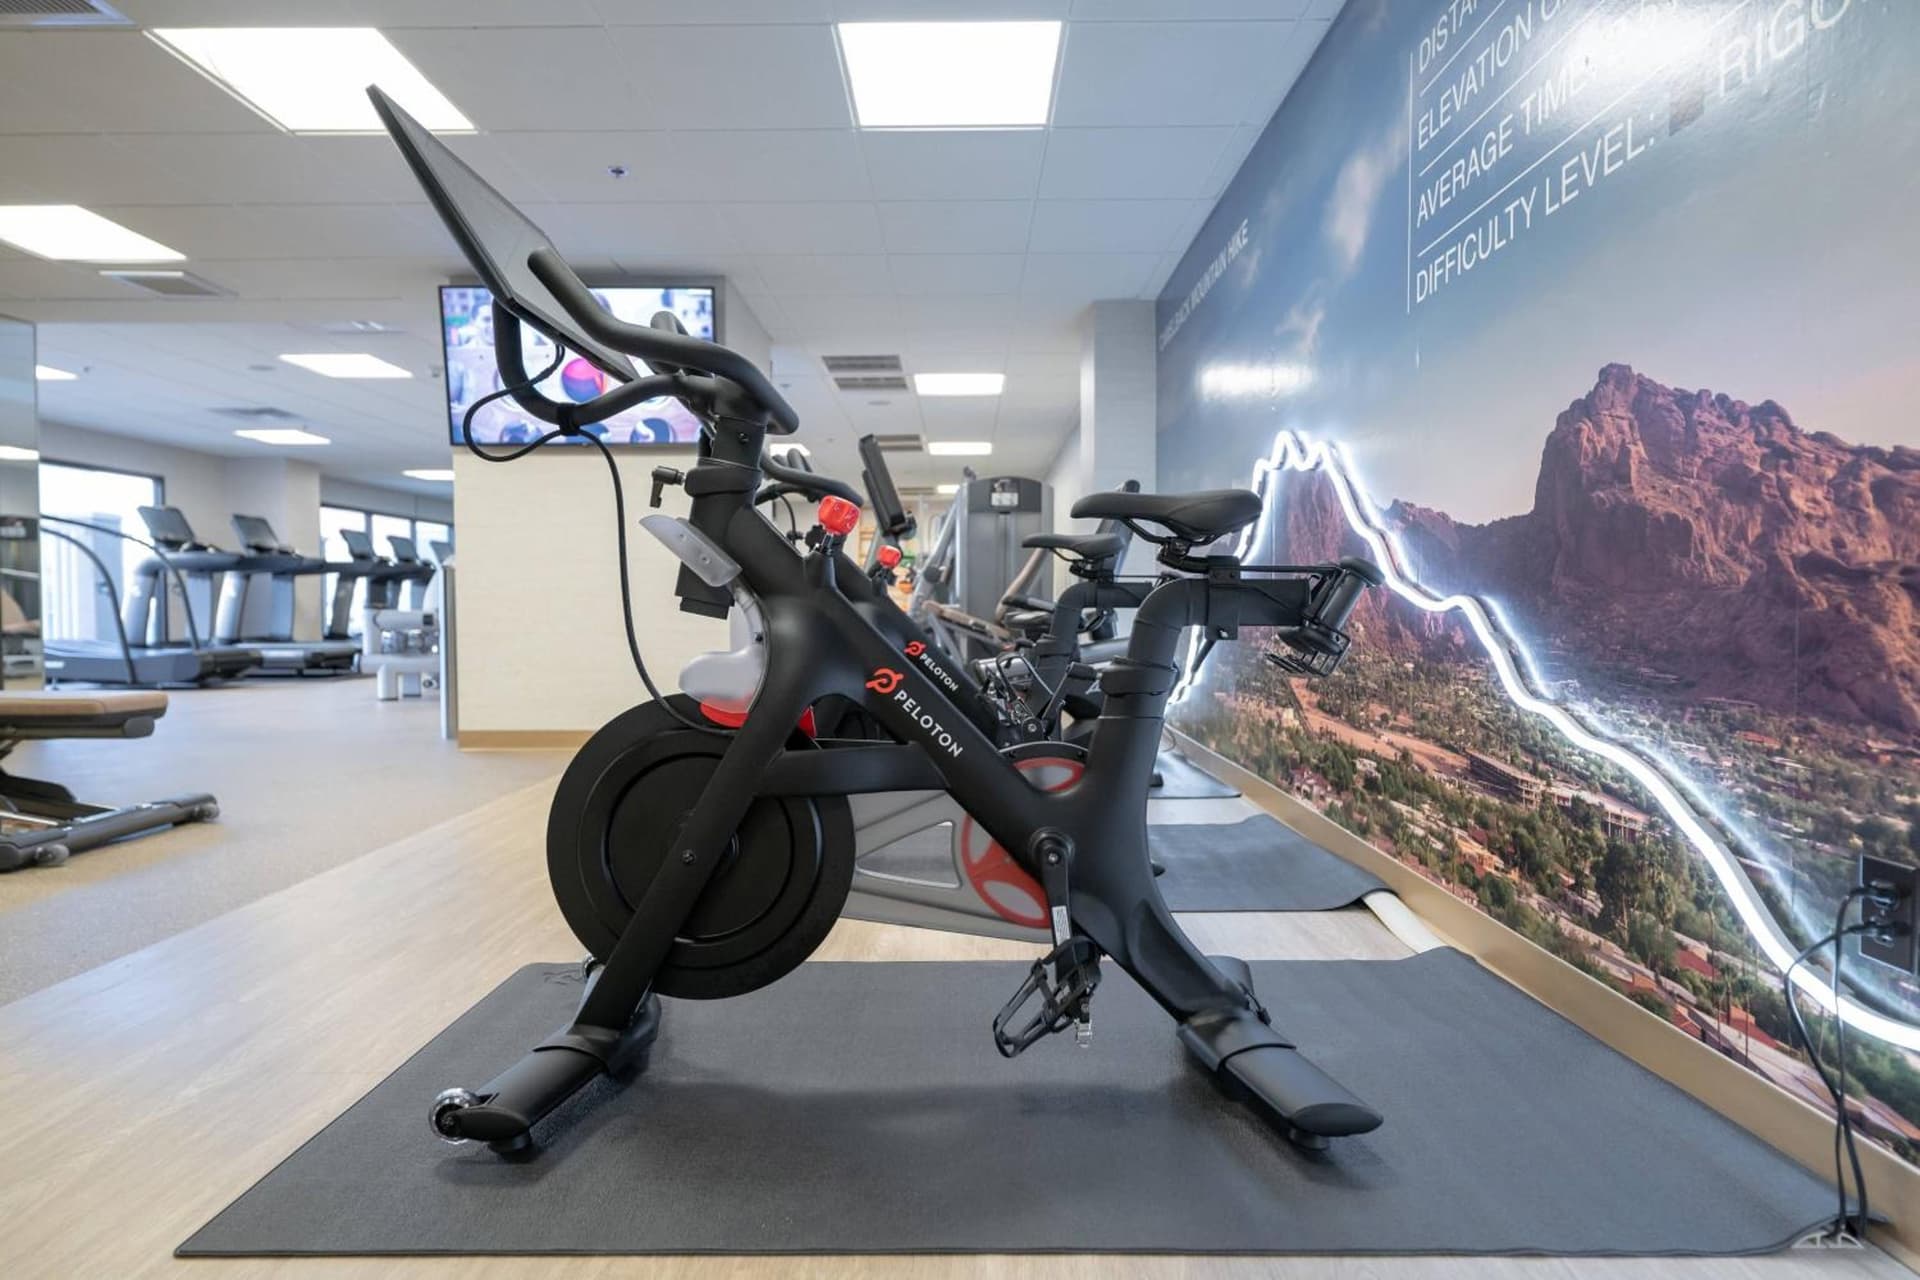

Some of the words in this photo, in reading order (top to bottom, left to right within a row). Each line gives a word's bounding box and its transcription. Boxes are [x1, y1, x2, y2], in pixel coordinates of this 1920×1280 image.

[1418, 1, 1532, 151] ELEVATION
[1419, 0, 1478, 74] DISTA
[1416, 113, 1514, 228] AVERAGE
[1416, 186, 1537, 304] DIFFICULTY
[1545, 111, 1655, 216] LEVEL:
[919, 652, 959, 692] PELOTON
[893, 689, 964, 758] PELOTON
